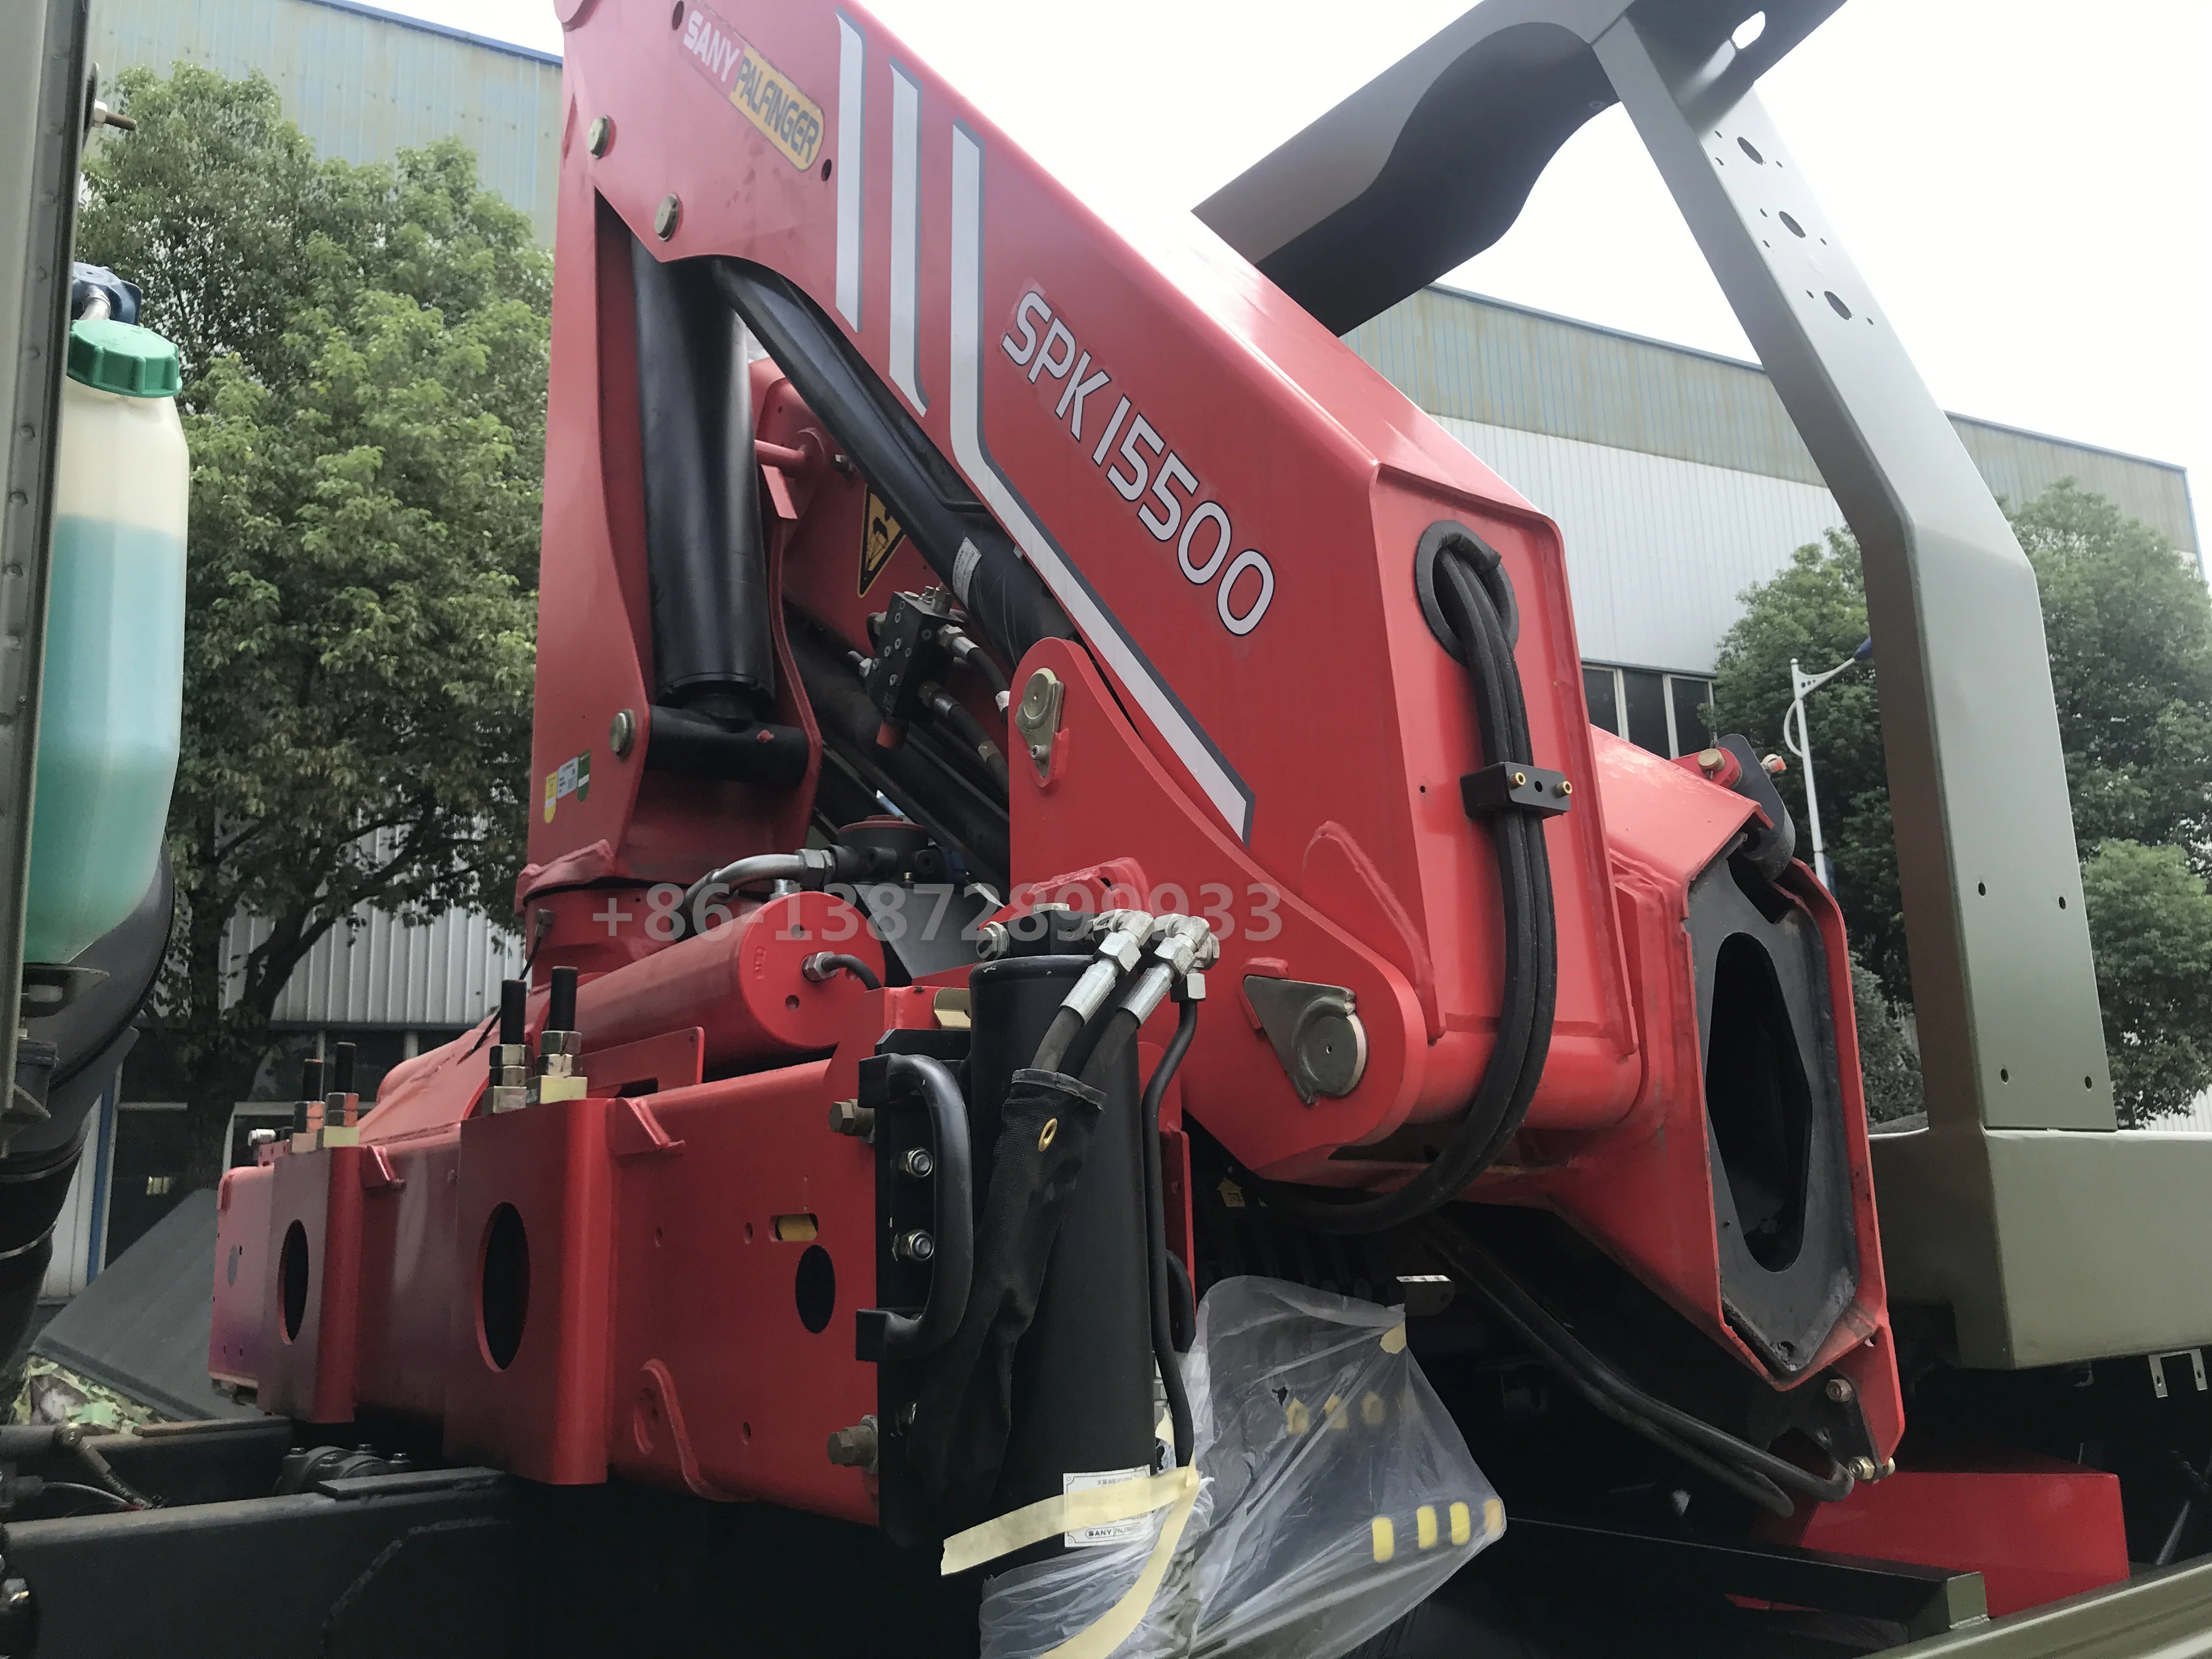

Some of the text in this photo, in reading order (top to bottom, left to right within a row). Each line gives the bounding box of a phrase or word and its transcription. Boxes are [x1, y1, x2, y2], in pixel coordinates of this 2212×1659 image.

[683, 10, 820, 164] SANY PALFINGER
[1001, 290, 1276, 636] SPK 15500
[1088, 1528, 1112, 1537] SANY
